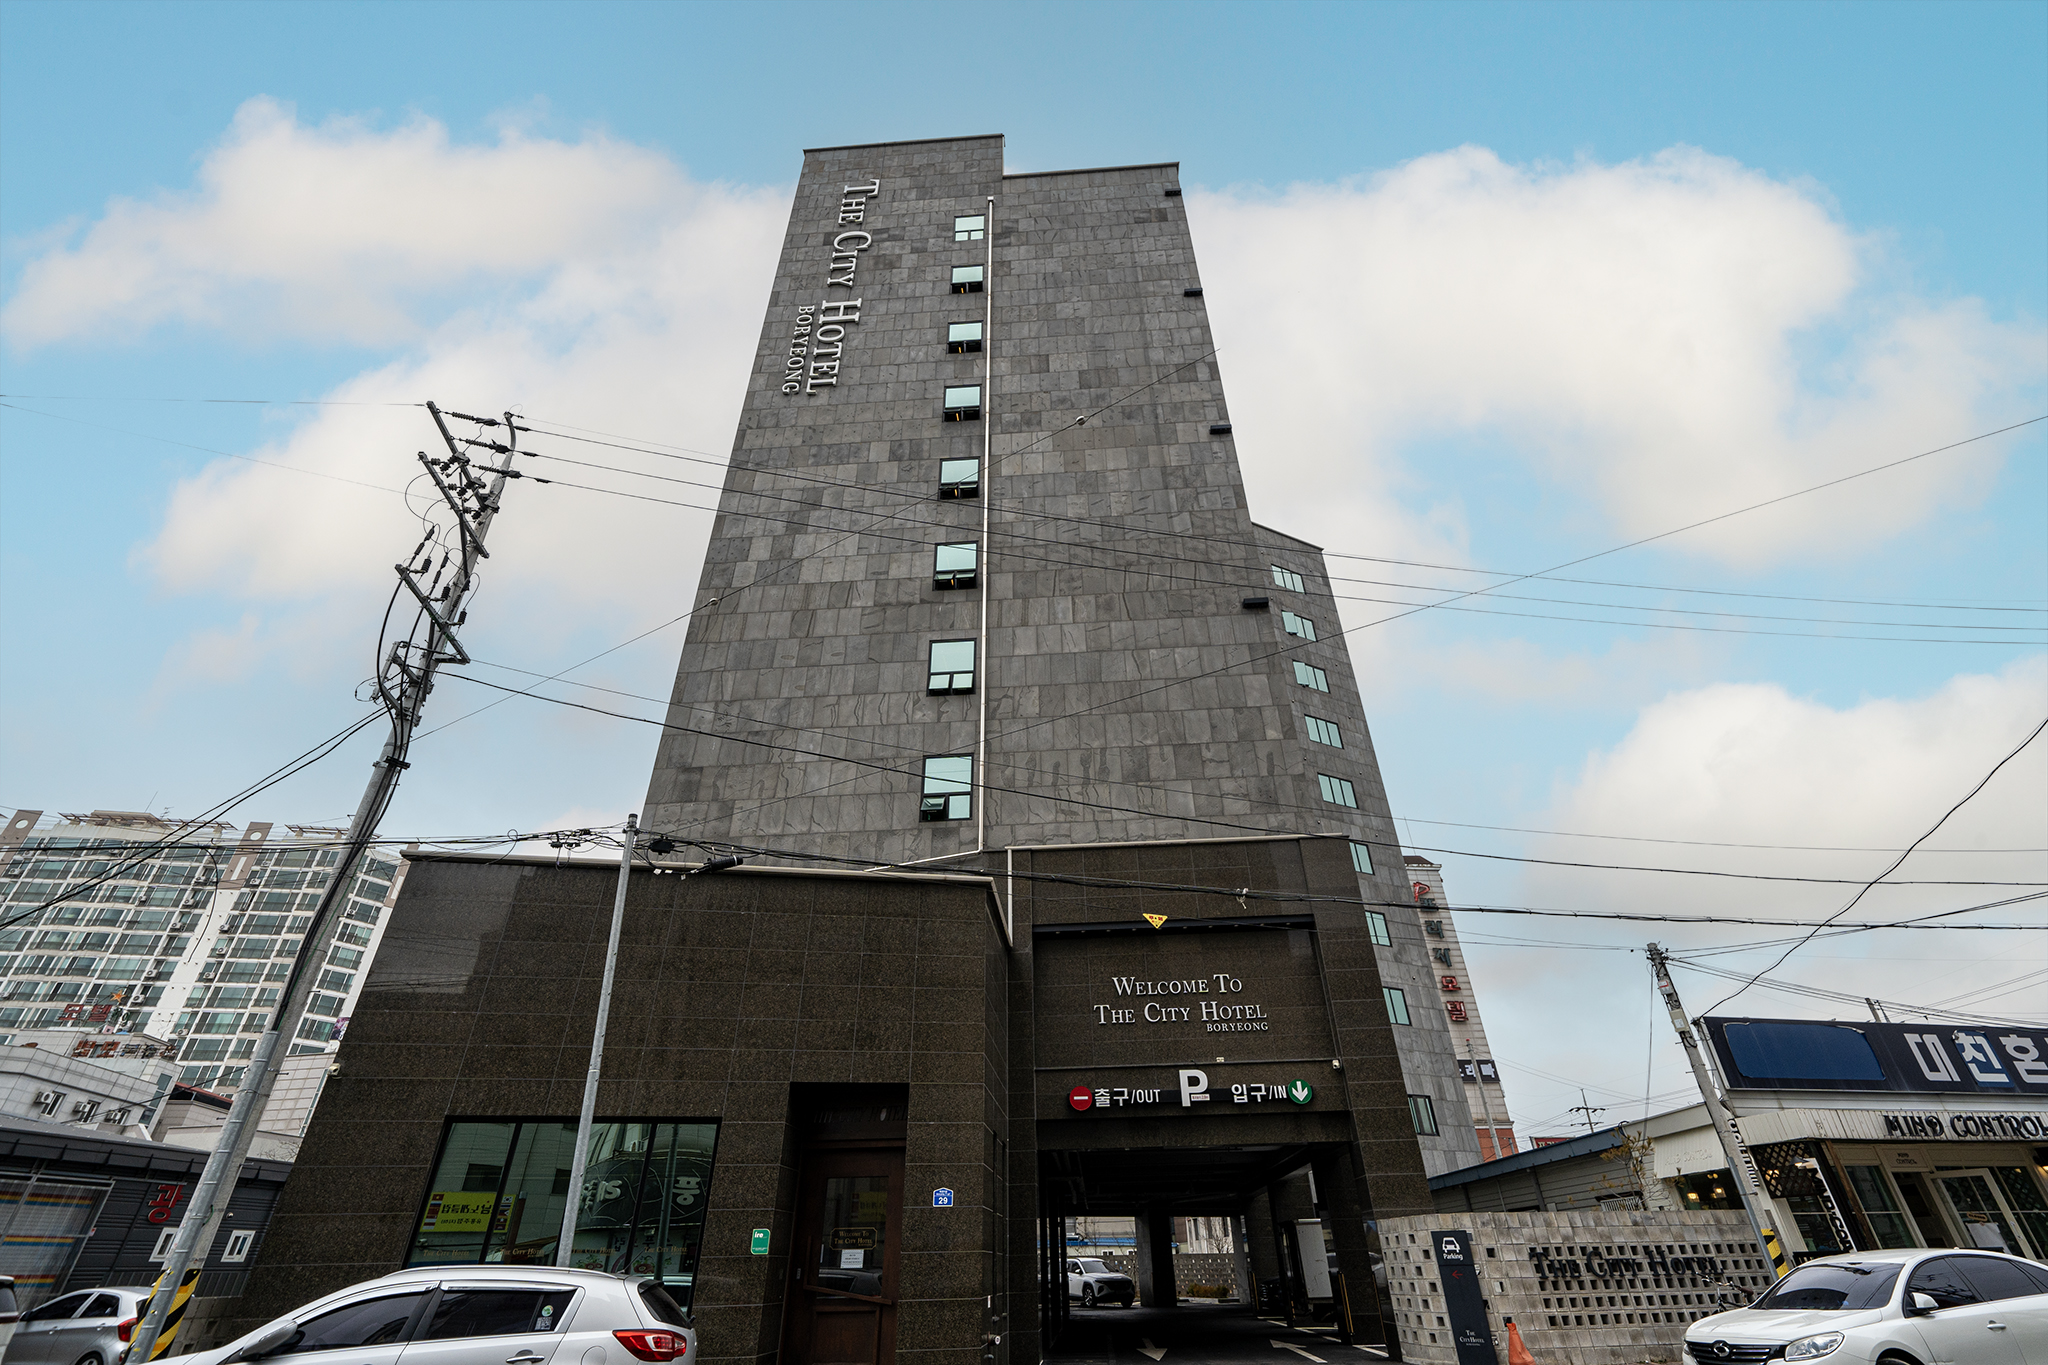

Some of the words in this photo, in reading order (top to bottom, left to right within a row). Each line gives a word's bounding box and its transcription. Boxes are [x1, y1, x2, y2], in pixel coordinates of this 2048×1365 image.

[837, 179, 880, 226] THE
[827, 231, 872, 287] CITY
[782, 305, 815, 395] BORYEONG
[806, 297, 862, 395] HOTEL
[1112, 976, 1209, 996] WELCOME
[1213, 974, 1242, 993] TO
[1094, 1004, 1135, 1024] THE
[1144, 1002, 1190, 1022] CITY
[1200, 1001, 1267, 1021] HOTEL
[1206, 1022, 1268, 1032] BORYEONG
[1179, 1069, 1209, 1107] P
[148, 1184, 185, 1223] 광
[938, 1196, 948, 1205] 29
[1442, 1252, 1464, 1261] Parking
[1529, 1251, 1582, 1279] THE
[1586, 1250, 1638, 1278] CITY
[1647, 1250, 1725, 1277] HOTEL
